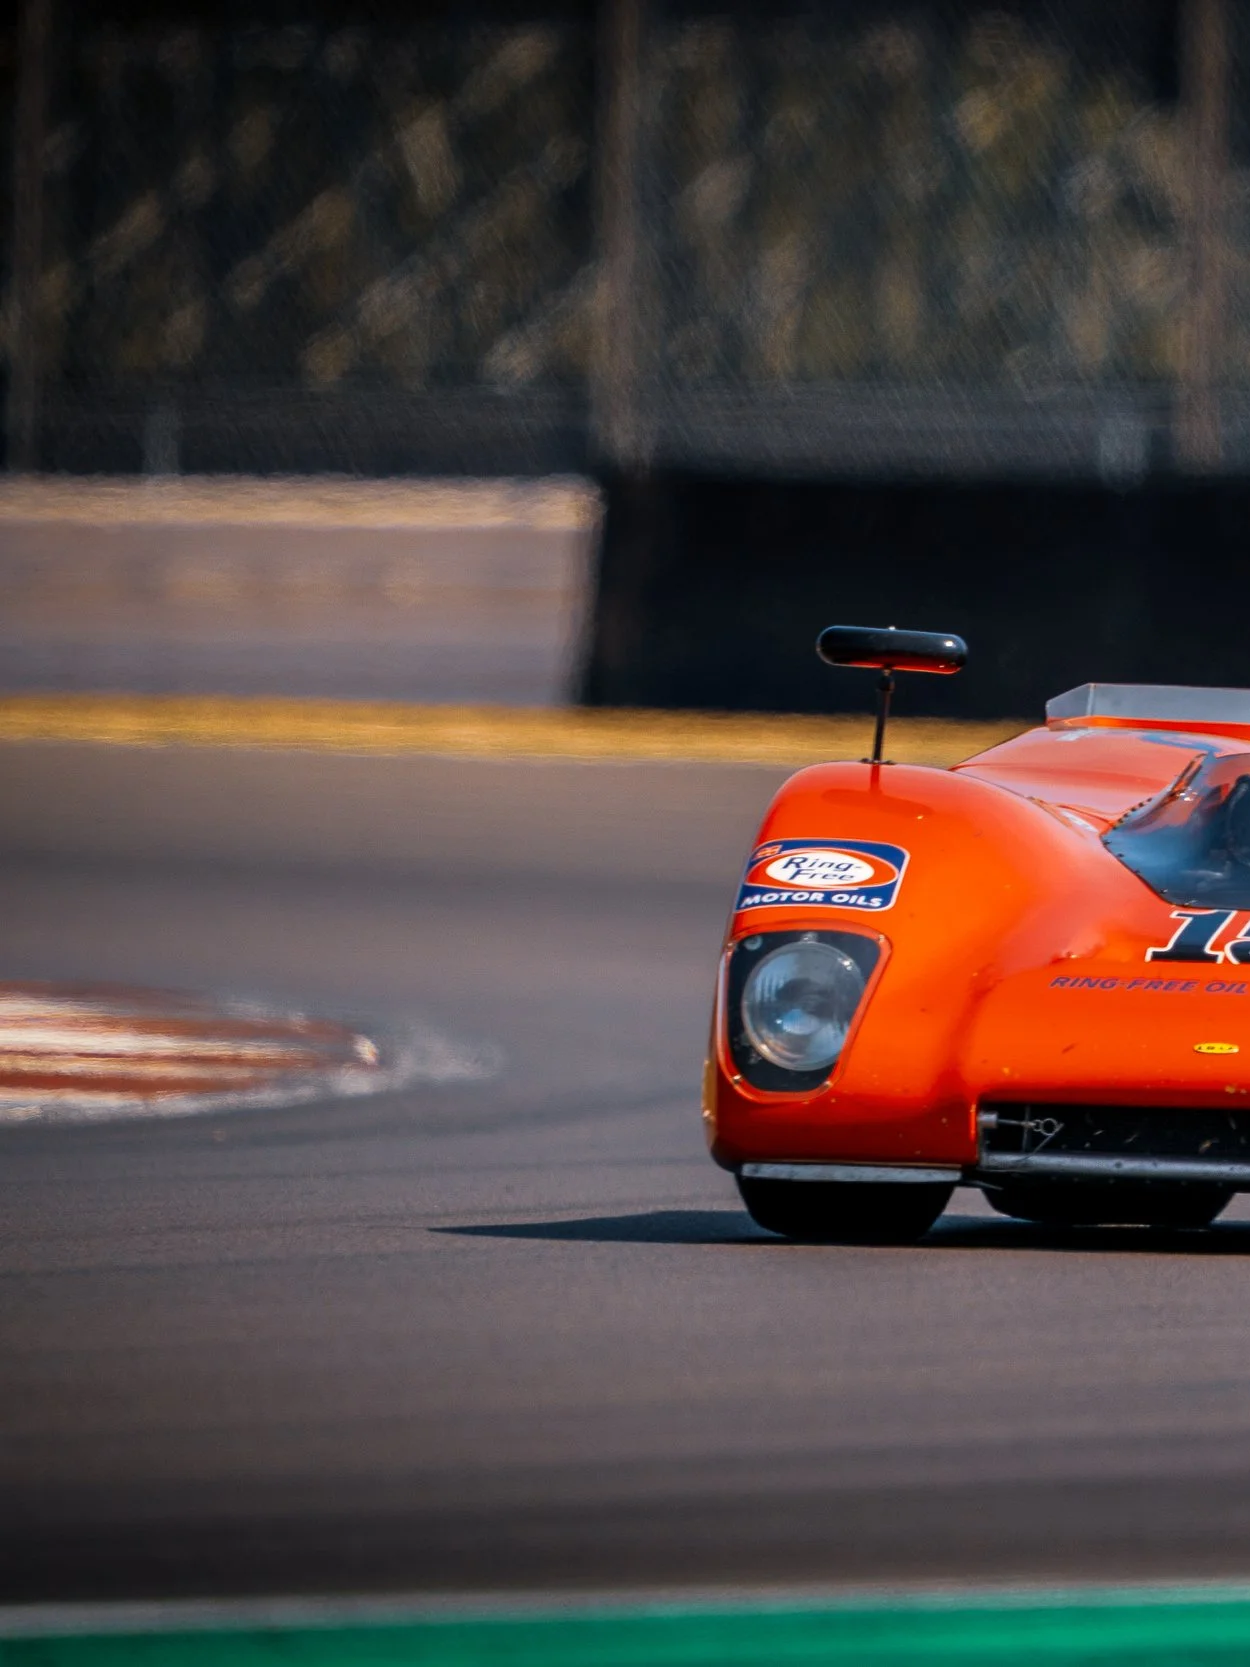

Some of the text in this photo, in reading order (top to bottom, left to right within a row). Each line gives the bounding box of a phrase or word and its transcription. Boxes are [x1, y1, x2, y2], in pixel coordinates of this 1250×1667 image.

[782, 856, 862, 872] Ring-
[788, 869, 855, 881] Free
[741, 891, 882, 908] MOTOR OILS
[1050, 976, 1200, 992] RING-FREE
[1205, 981, 1249, 994] OIL
